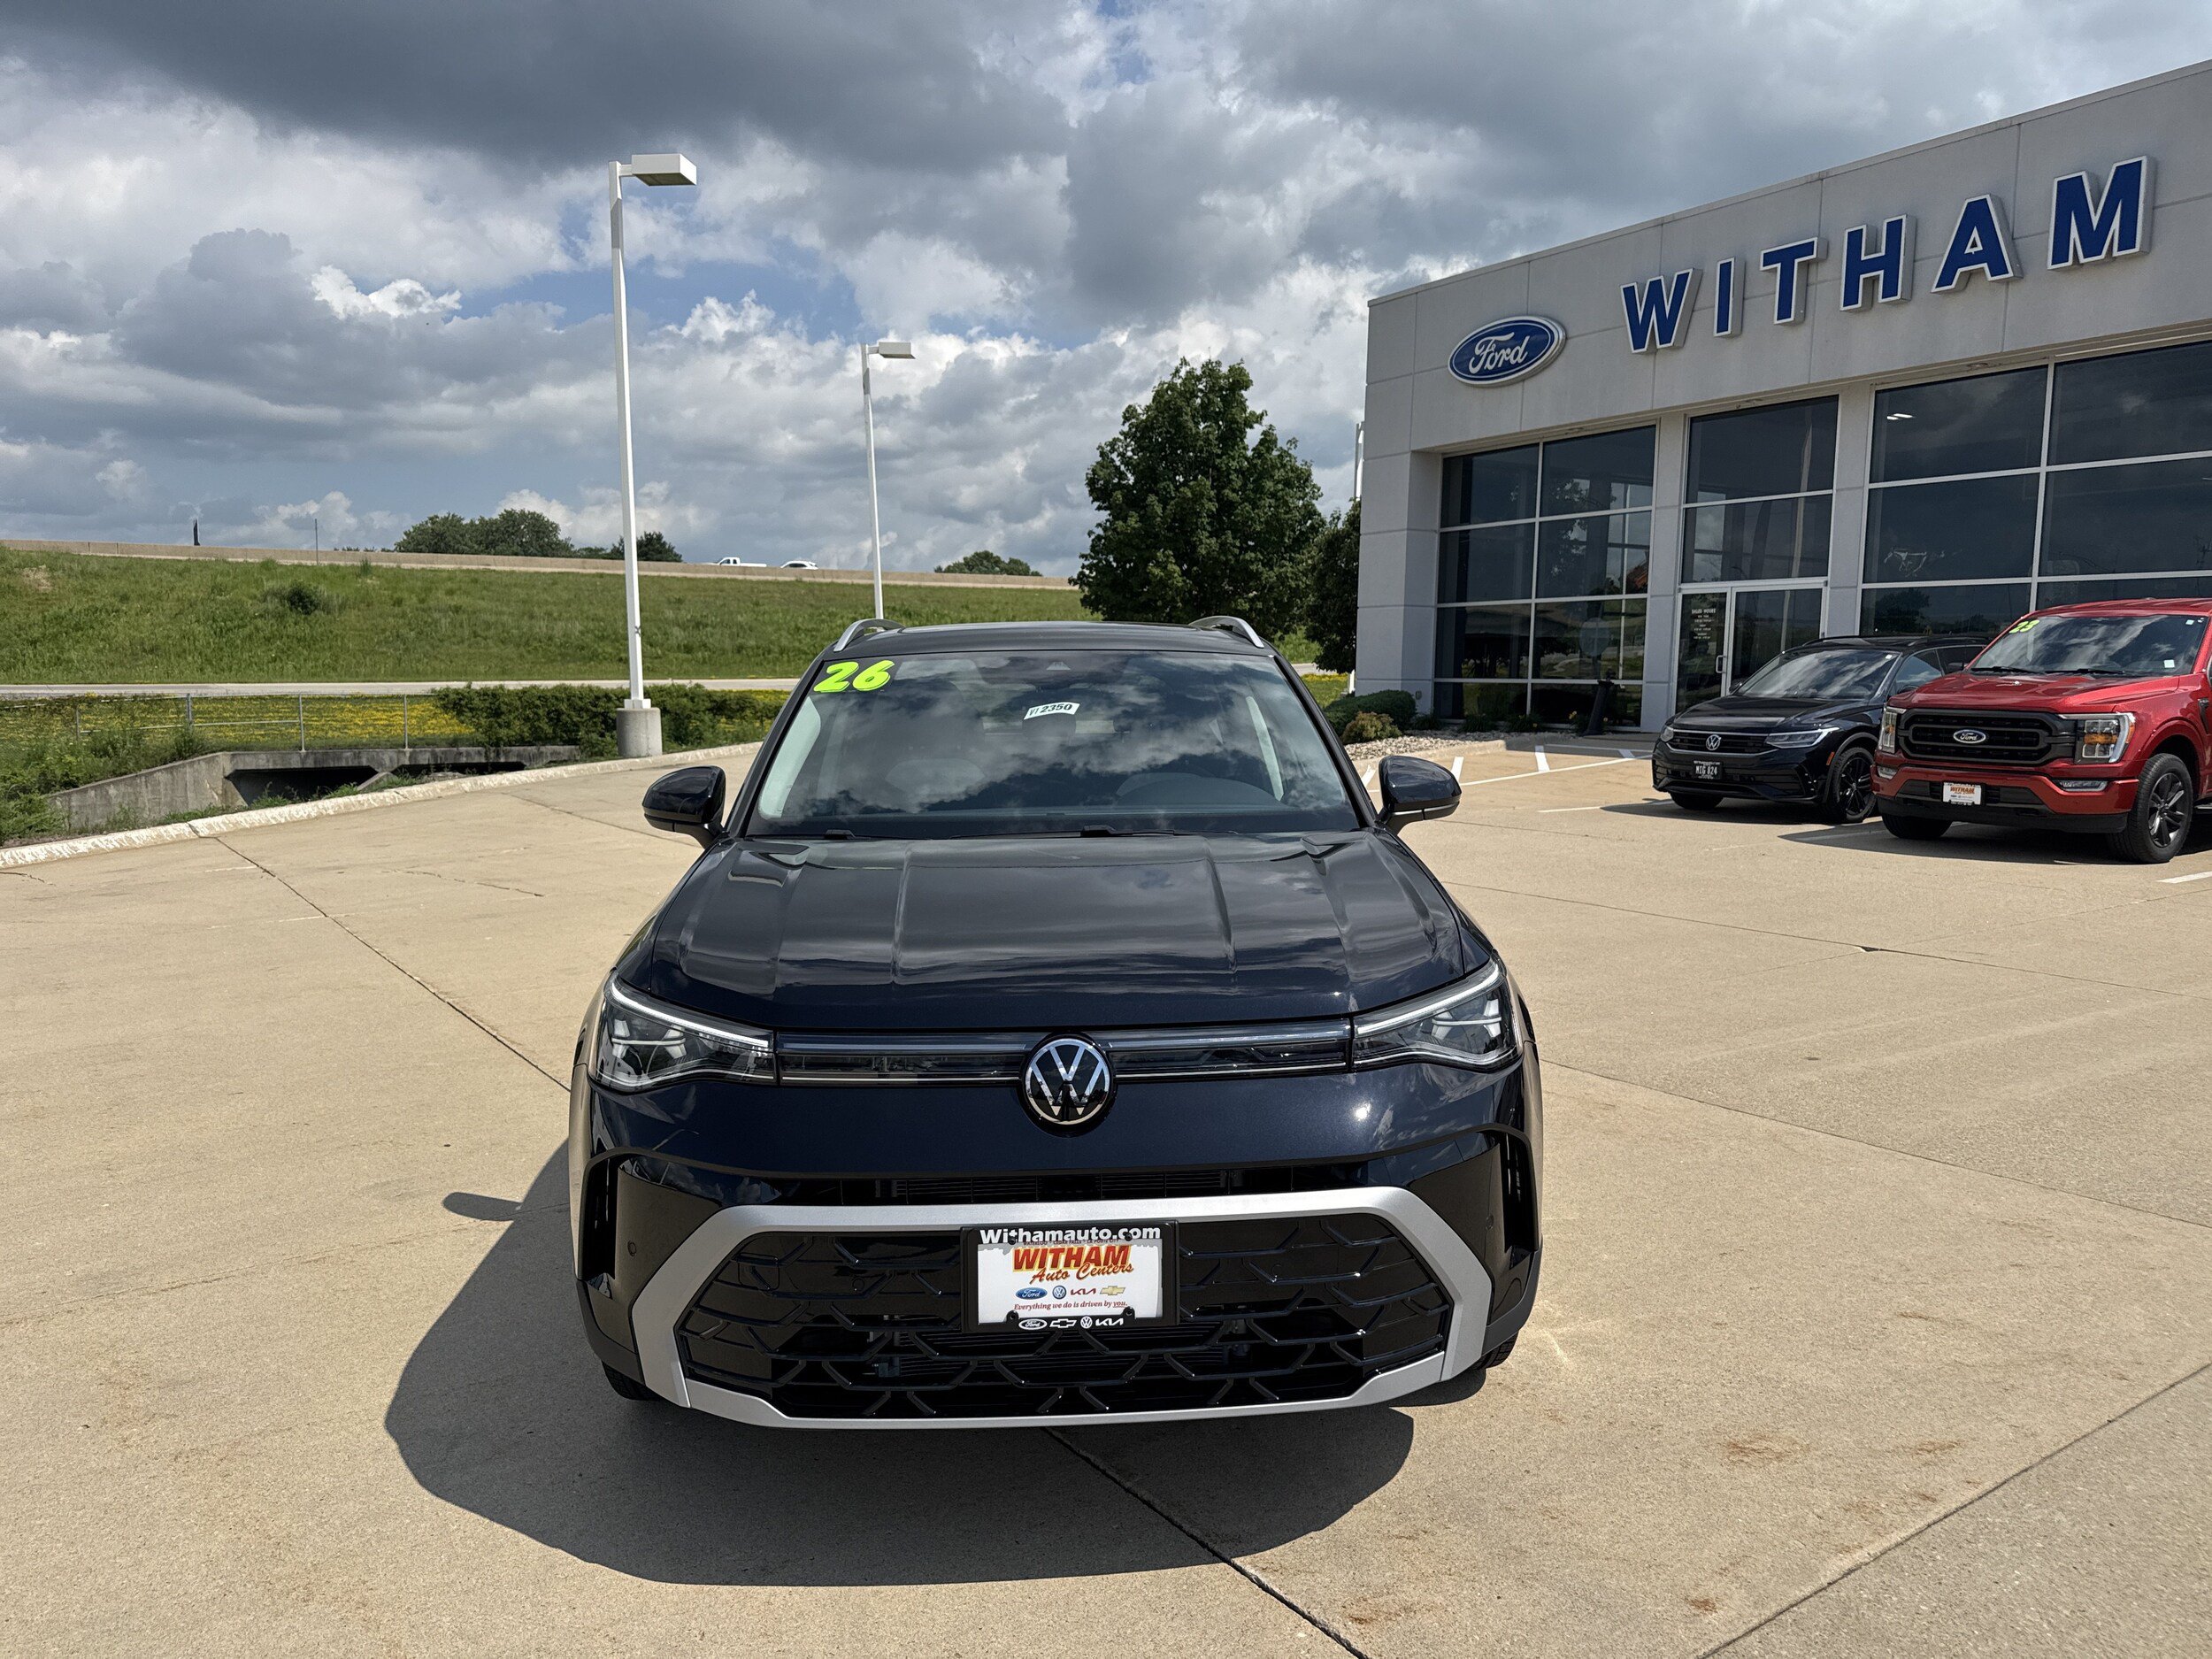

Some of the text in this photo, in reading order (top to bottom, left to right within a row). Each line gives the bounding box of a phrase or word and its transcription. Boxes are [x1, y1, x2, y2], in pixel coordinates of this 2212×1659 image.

[1620, 156, 2155, 353] WITHAM
[1469, 332, 1530, 374] Ford
[814, 659, 895, 693] 26
[979, 1226, 1161, 1244] Withamauto.com
[1012, 1245, 1132, 1271] WITHAM
[1029, 1262, 1134, 1284] Auto Centers
[1014, 1302, 1051, 1311] Everything
